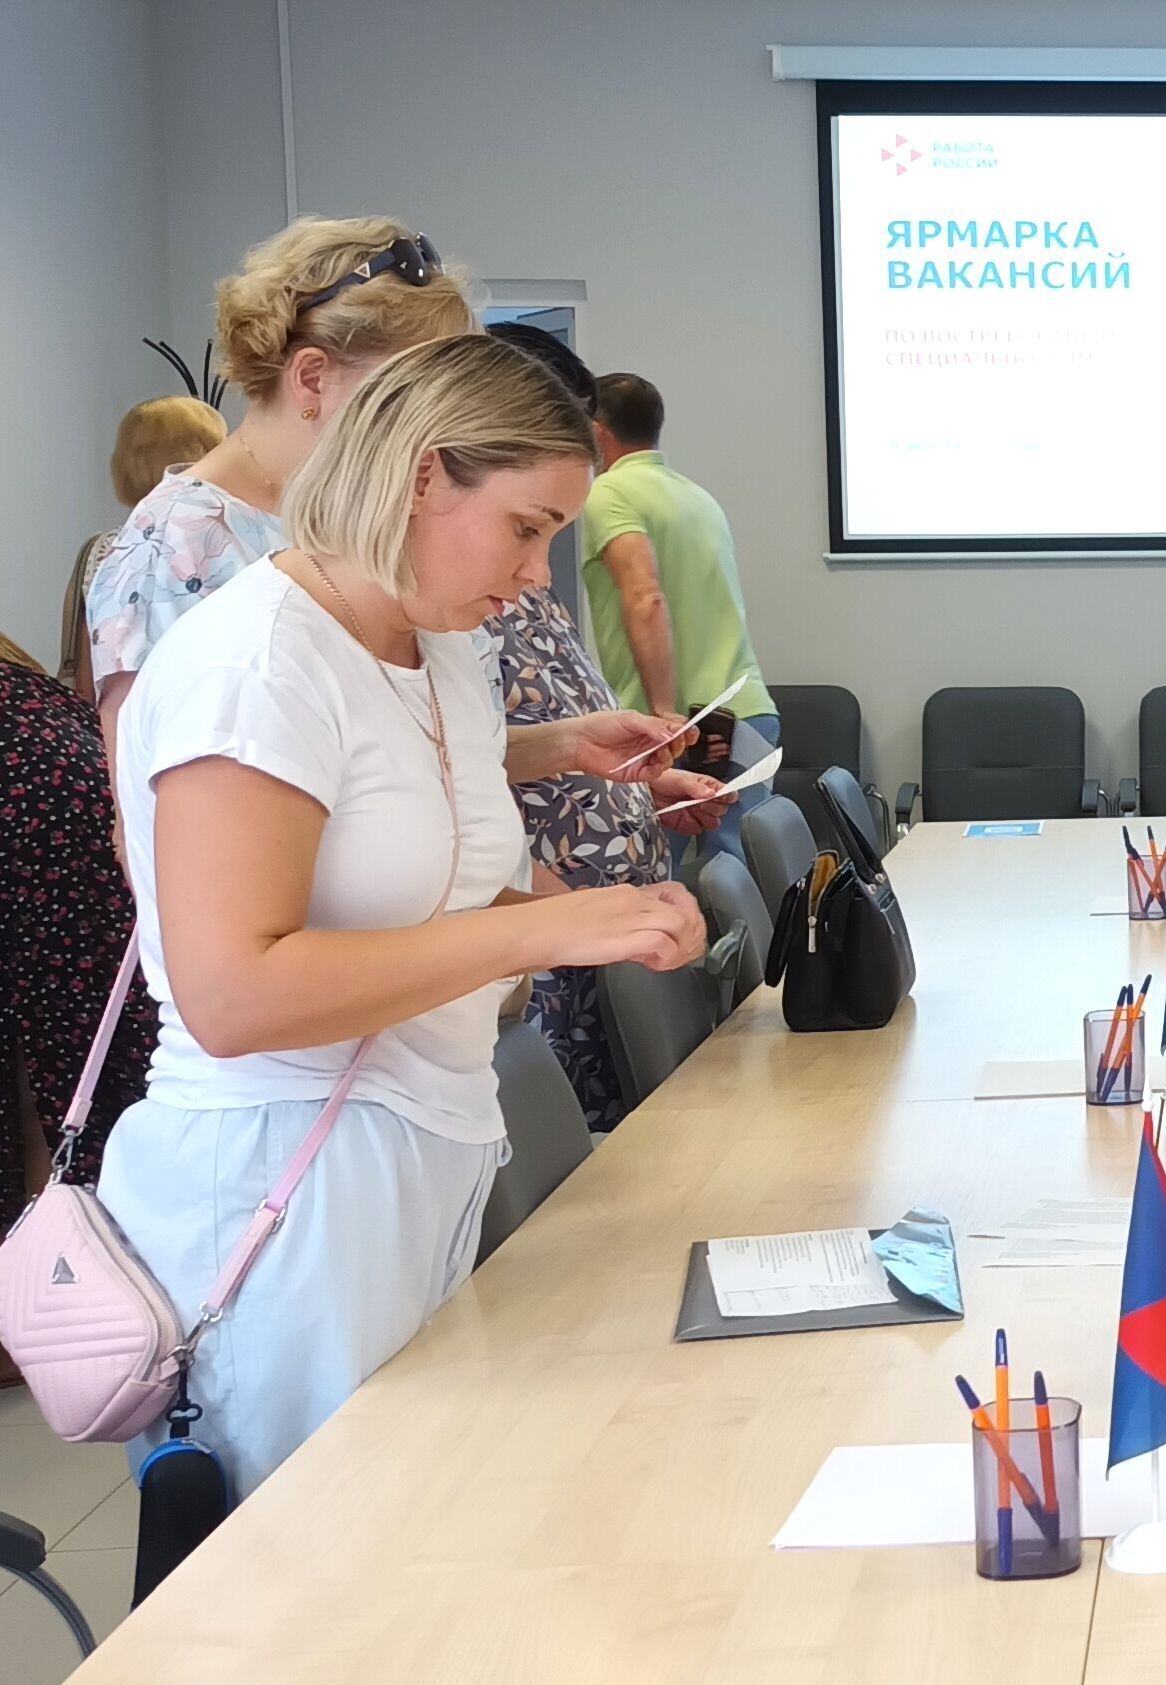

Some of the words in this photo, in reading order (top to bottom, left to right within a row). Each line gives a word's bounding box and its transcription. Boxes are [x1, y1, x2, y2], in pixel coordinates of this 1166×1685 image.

[932, 142, 995, 153] РАБОТА
[932, 157, 998, 169] РОССИИ
[886, 219, 1100, 249] ЯРМАРКА
[887, 251, 1131, 290] ВАКАНСИЙ
